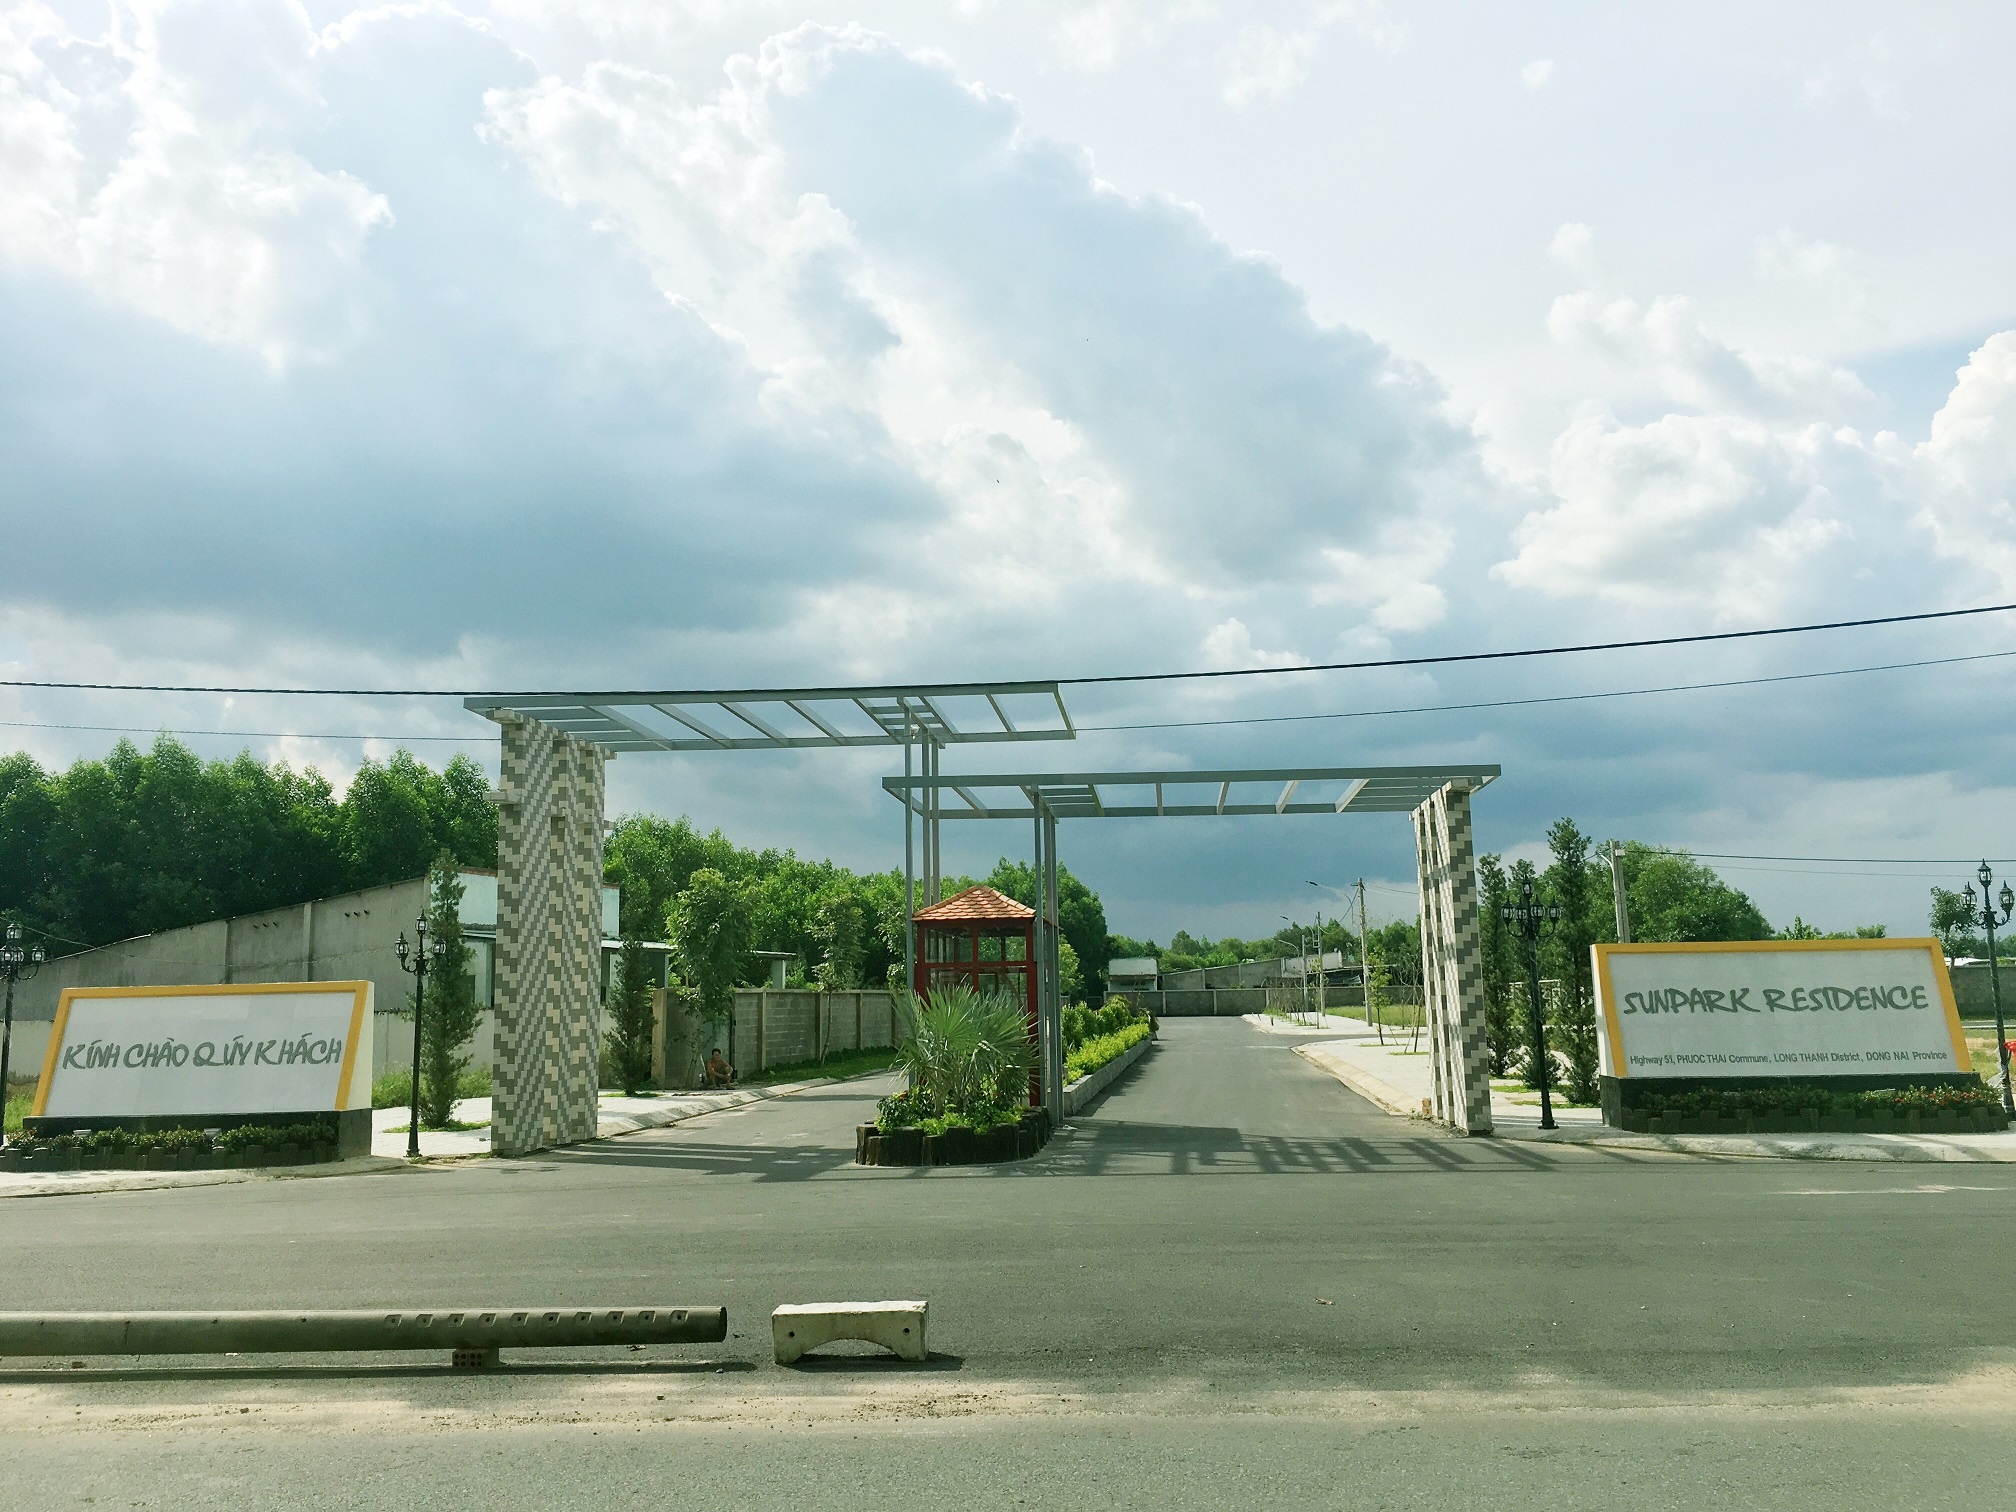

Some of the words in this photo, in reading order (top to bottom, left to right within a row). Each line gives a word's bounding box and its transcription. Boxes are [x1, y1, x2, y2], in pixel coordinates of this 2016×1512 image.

[1623, 988, 1760, 1014] SUNPARK
[1762, 985, 1929, 1012] RESIDENCE
[62, 1039, 121, 1069] KÍNH
[123, 1037, 190, 1068] CHÀO
[253, 1032, 342, 1065] KHÁCH
[1630, 1055, 1663, 1066] Highway
[1676, 1054, 1706, 1064] PHUOC
[1706, 1054, 1727, 1063] THAI
[1774, 1053, 1798, 1062] LONG
[1798, 1053, 1829, 1062] THANH
[1866, 1051, 1891, 1061] DONG
[1894, 1051, 1910, 1061] NAI
[1912, 1051, 1947, 1061] Province
